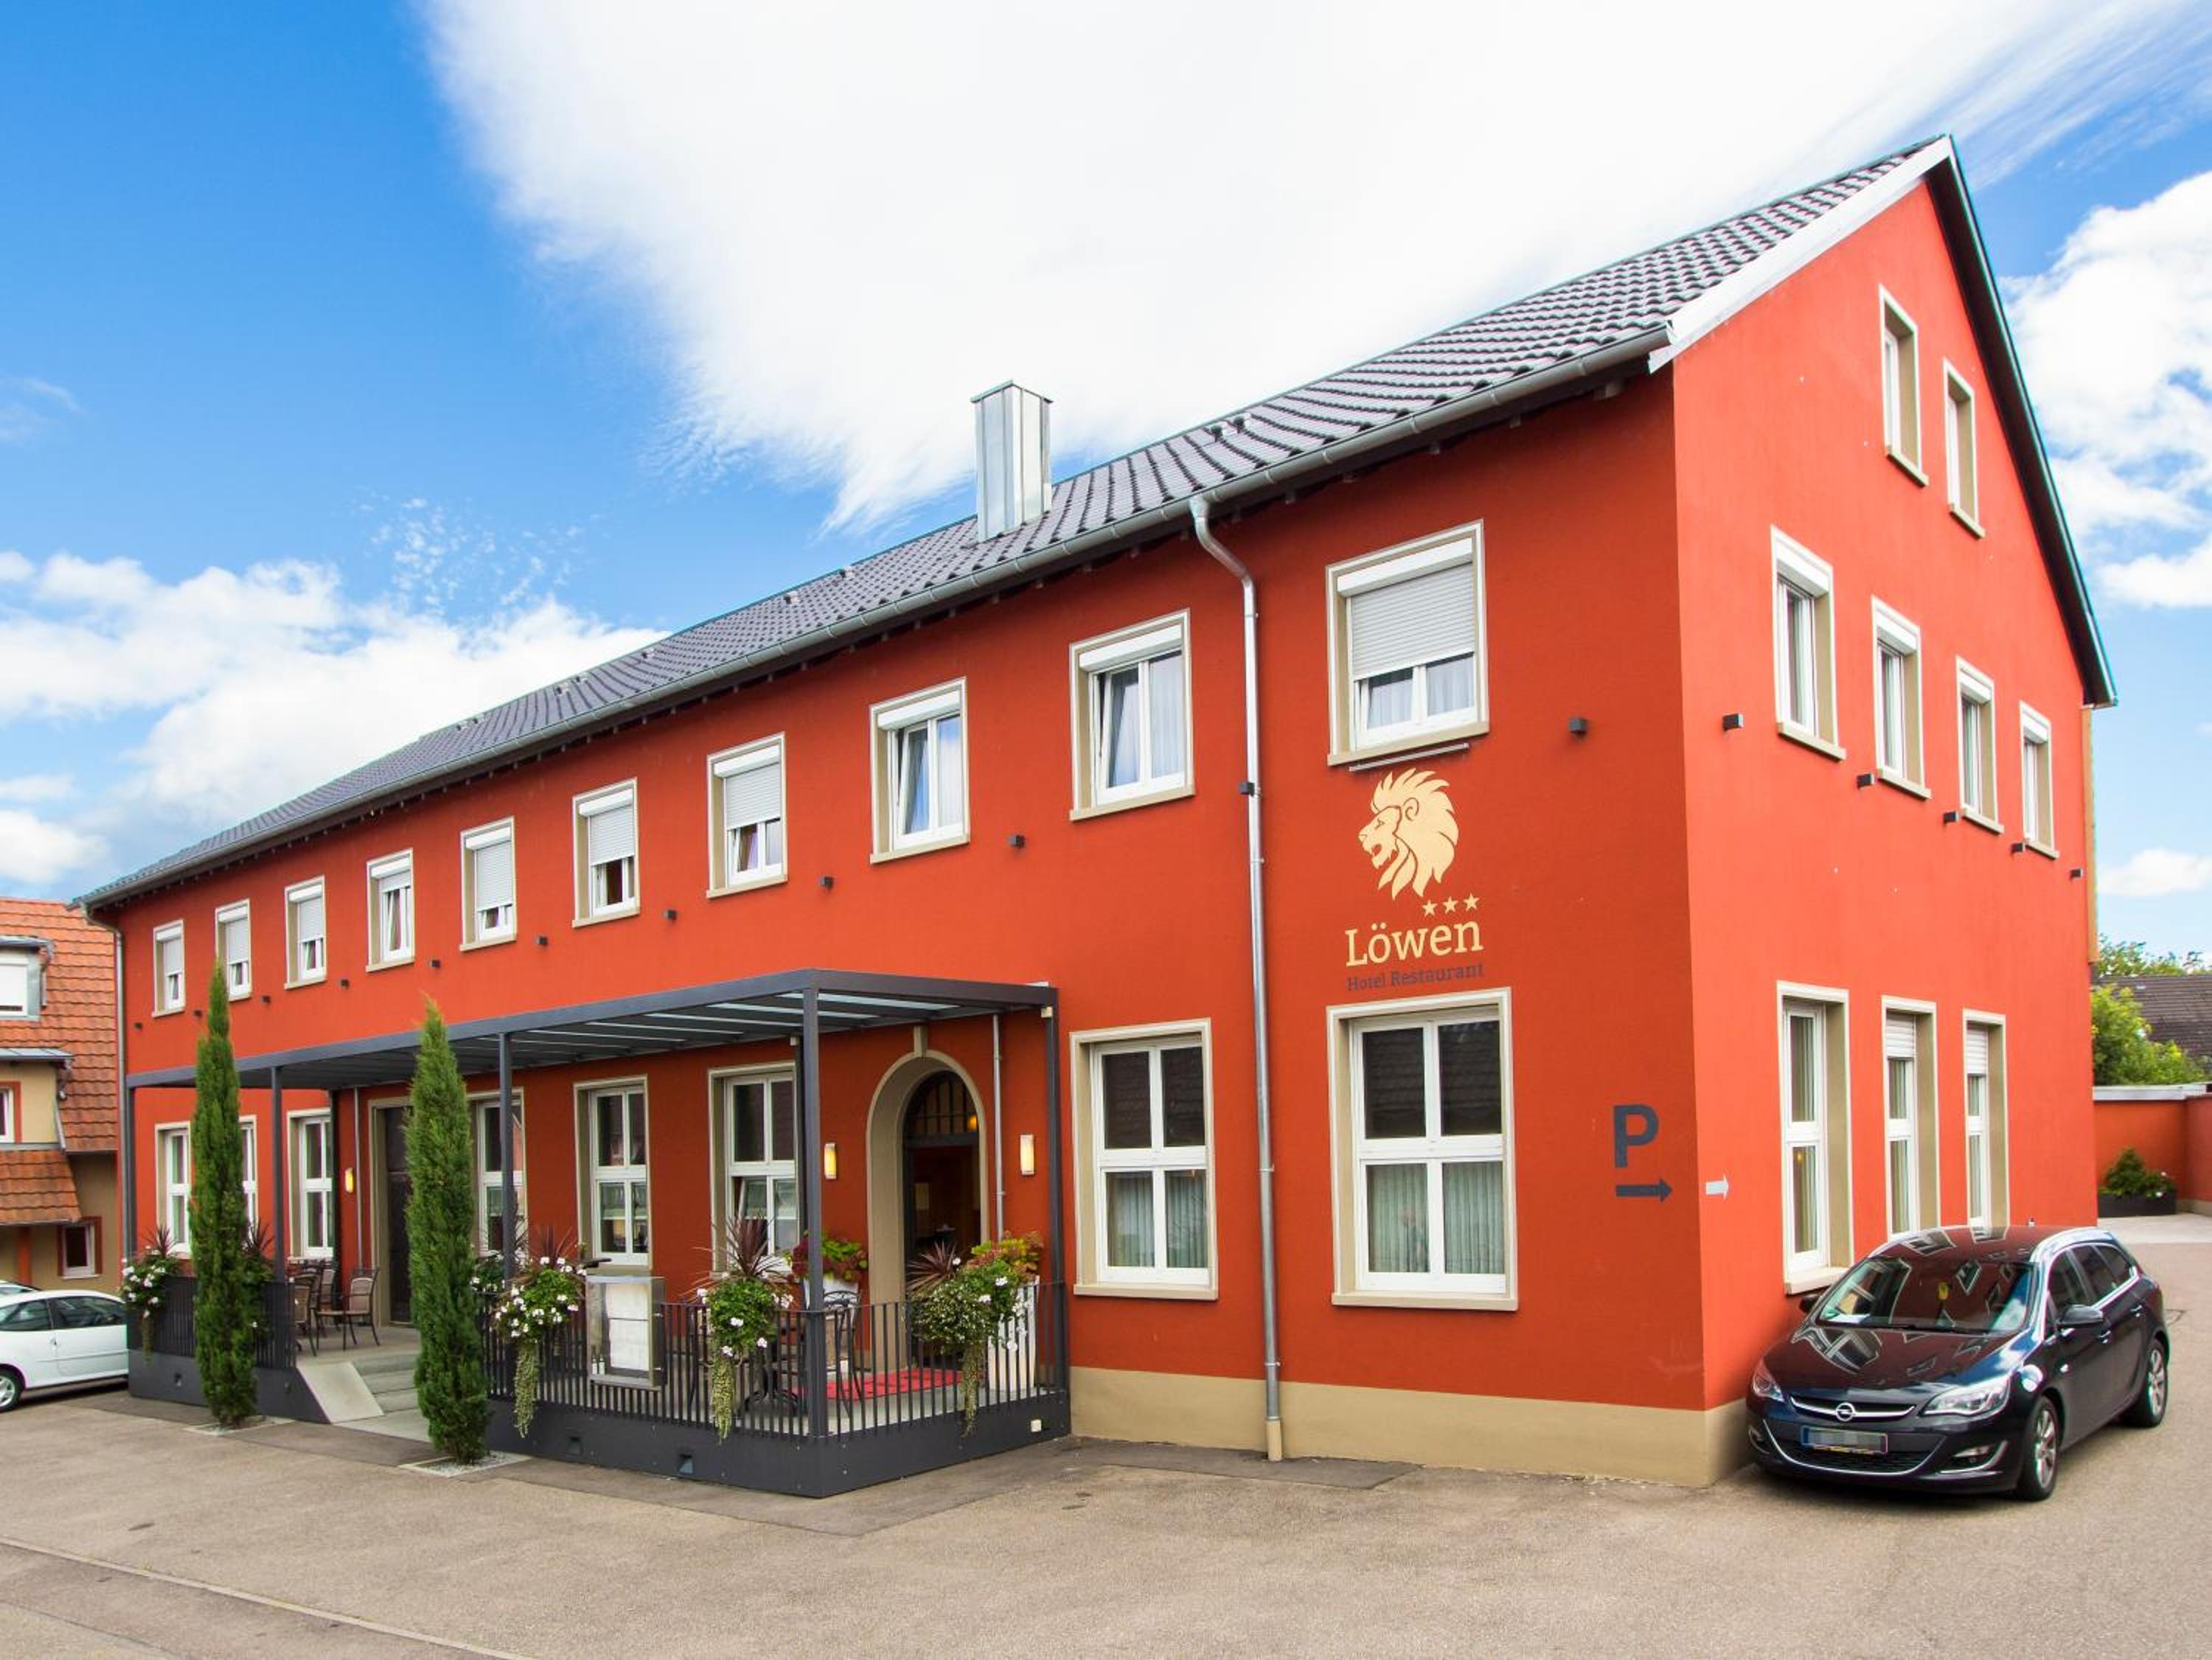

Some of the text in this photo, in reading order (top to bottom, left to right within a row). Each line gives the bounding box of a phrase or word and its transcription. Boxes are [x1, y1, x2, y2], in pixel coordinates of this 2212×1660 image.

[1345, 921, 1484, 966] Löwen
[1347, 962, 1484, 991] Hotel Restaurant
[1613, 1104, 1658, 1168] P
